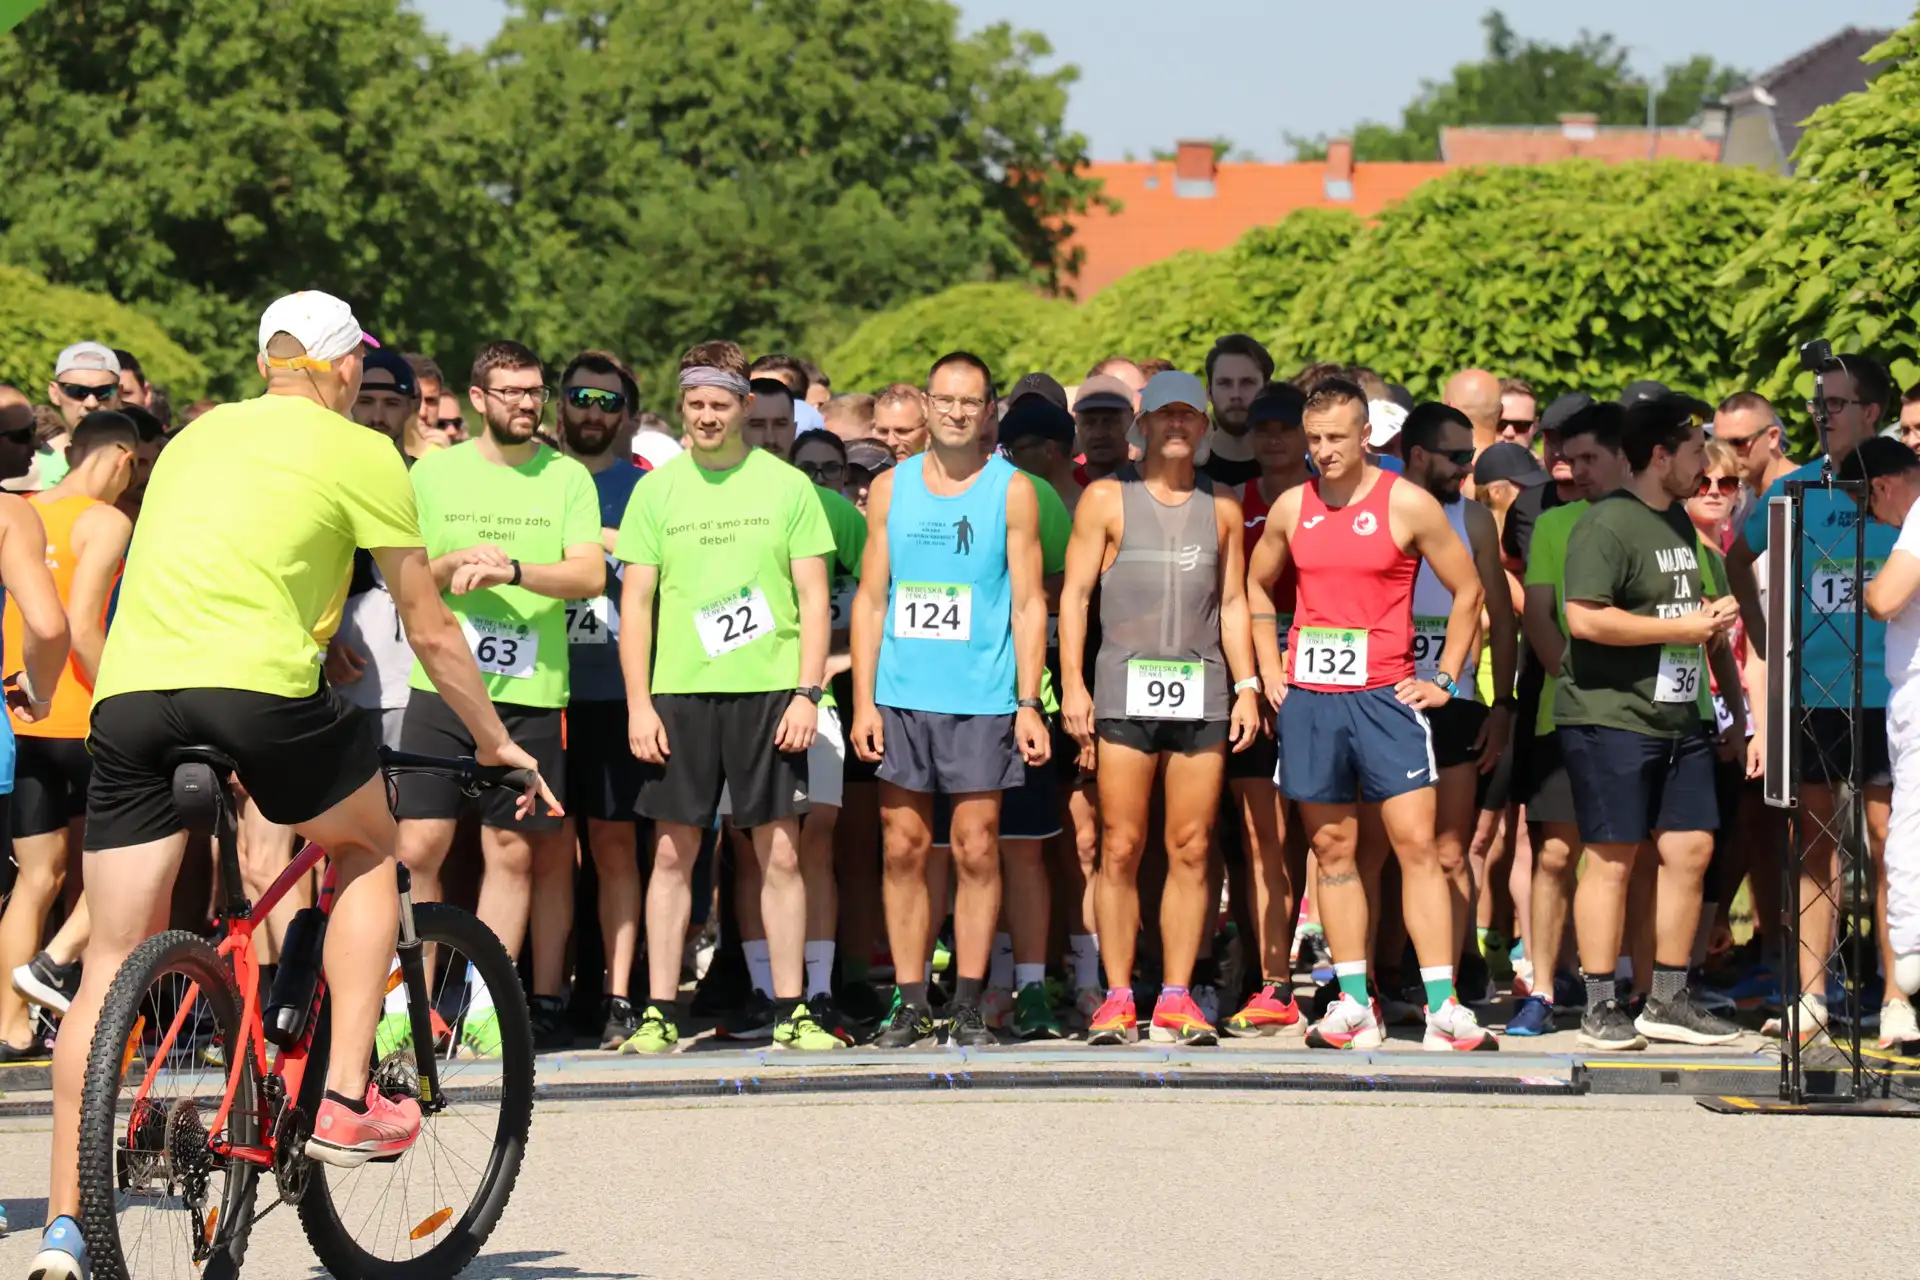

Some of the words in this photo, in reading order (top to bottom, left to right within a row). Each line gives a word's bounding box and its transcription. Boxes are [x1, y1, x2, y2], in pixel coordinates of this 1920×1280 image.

[497, 516, 522, 525] smo
[525, 517, 551, 527] zato
[716, 519, 740, 530] smo
[744, 516, 770, 526] zato
[478, 530, 515, 541] debeli
[700, 533, 736, 545] debeli
[1673, 574, 1691, 598] ZA
[716, 606, 758, 642] 22
[905, 602, 960, 630] 124
[477, 636, 518, 666] 63
[1412, 635, 1447, 661] 97
[1305, 648, 1356, 675] 132
[1672, 667, 1697, 693] 36
[1147, 680, 1185, 707] 99
